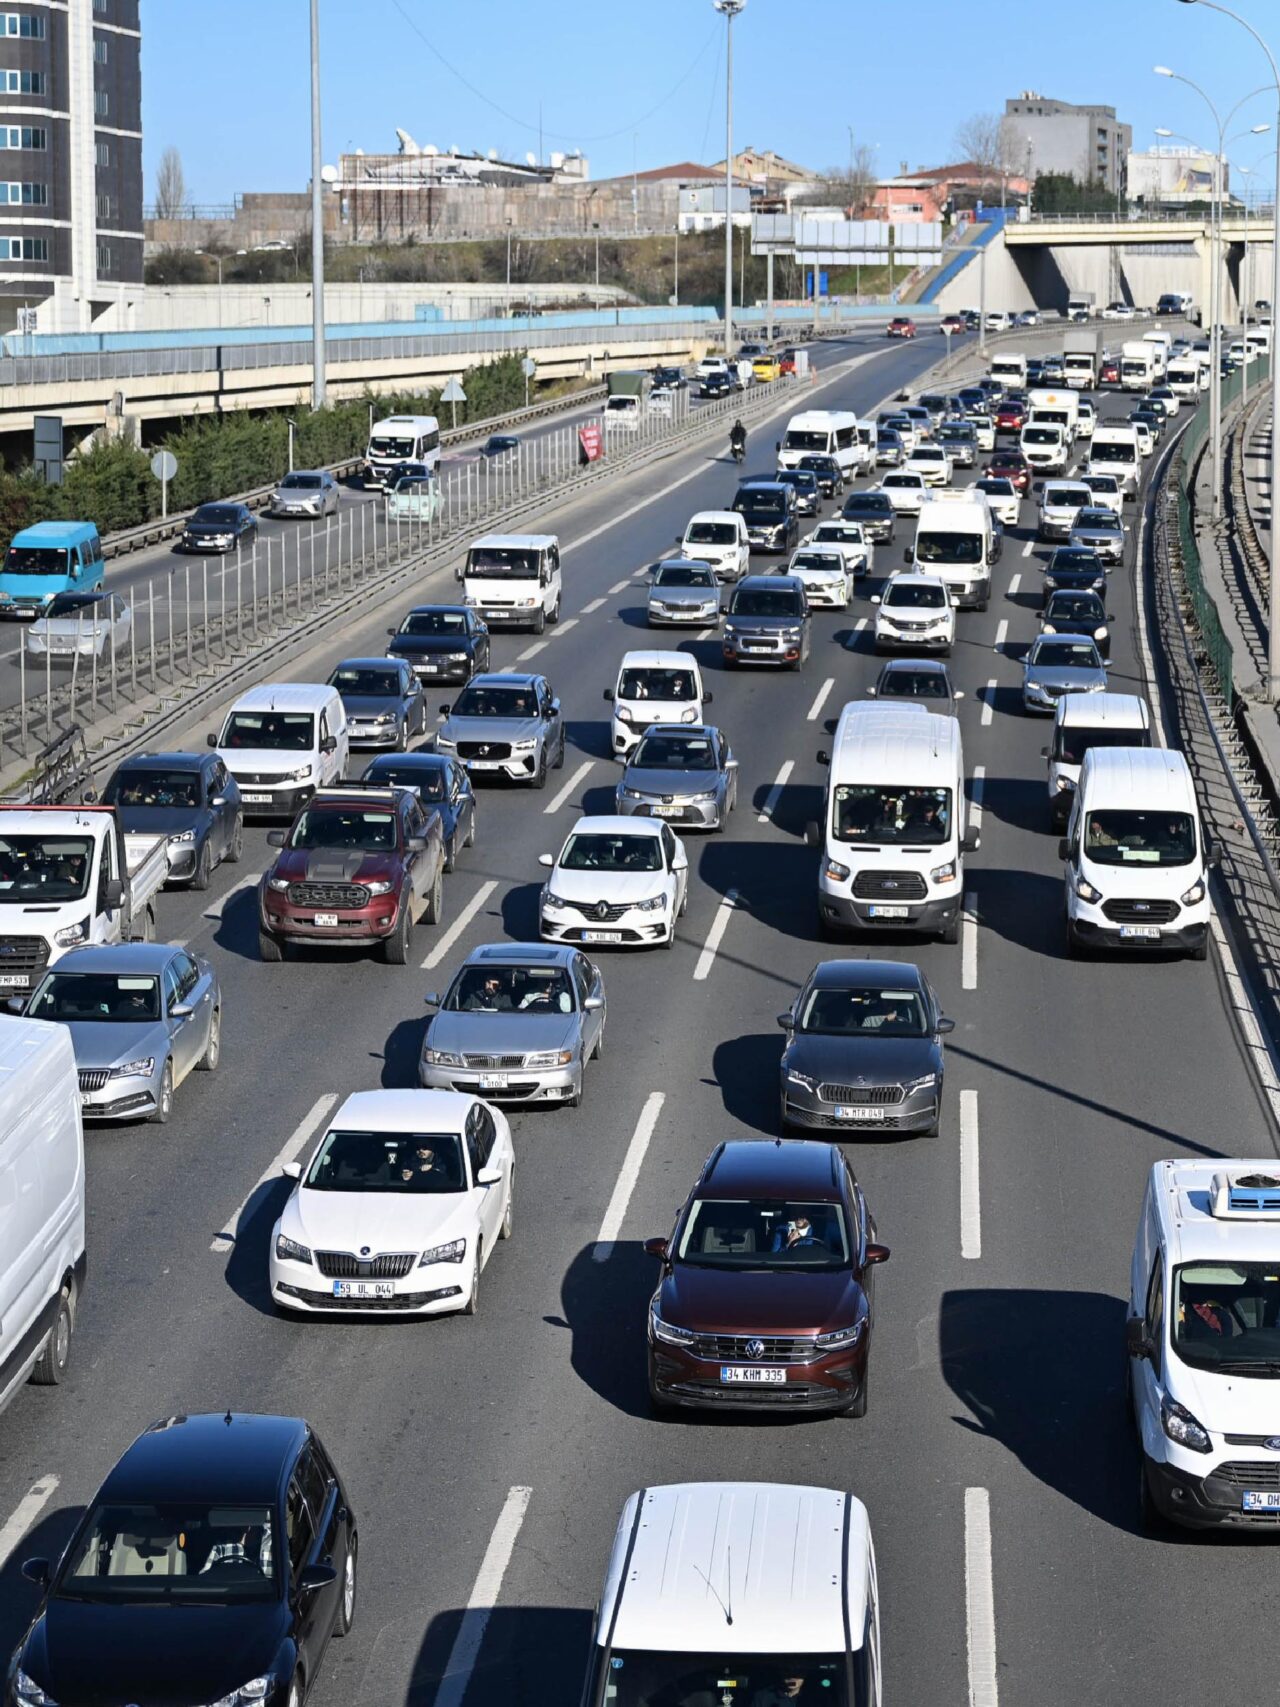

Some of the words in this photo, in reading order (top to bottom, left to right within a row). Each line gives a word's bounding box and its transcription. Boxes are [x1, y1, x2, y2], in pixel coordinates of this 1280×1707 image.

[13, 976, 28, 986] 533
[487, 1080, 503, 1088] 0100
[840, 1106, 849, 1117] 34
[851, 1106, 866, 1118] MTR
[868, 1107, 882, 1118] 049
[340, 1283, 351, 1295] 59
[358, 1283, 369, 1295] UL
[375, 1284, 392, 1295] 044
[727, 1369, 739, 1380] 34
[742, 1369, 761, 1380] KHM
[765, 1370, 783, 1381] 335
[1250, 1494, 1262, 1505] 34
